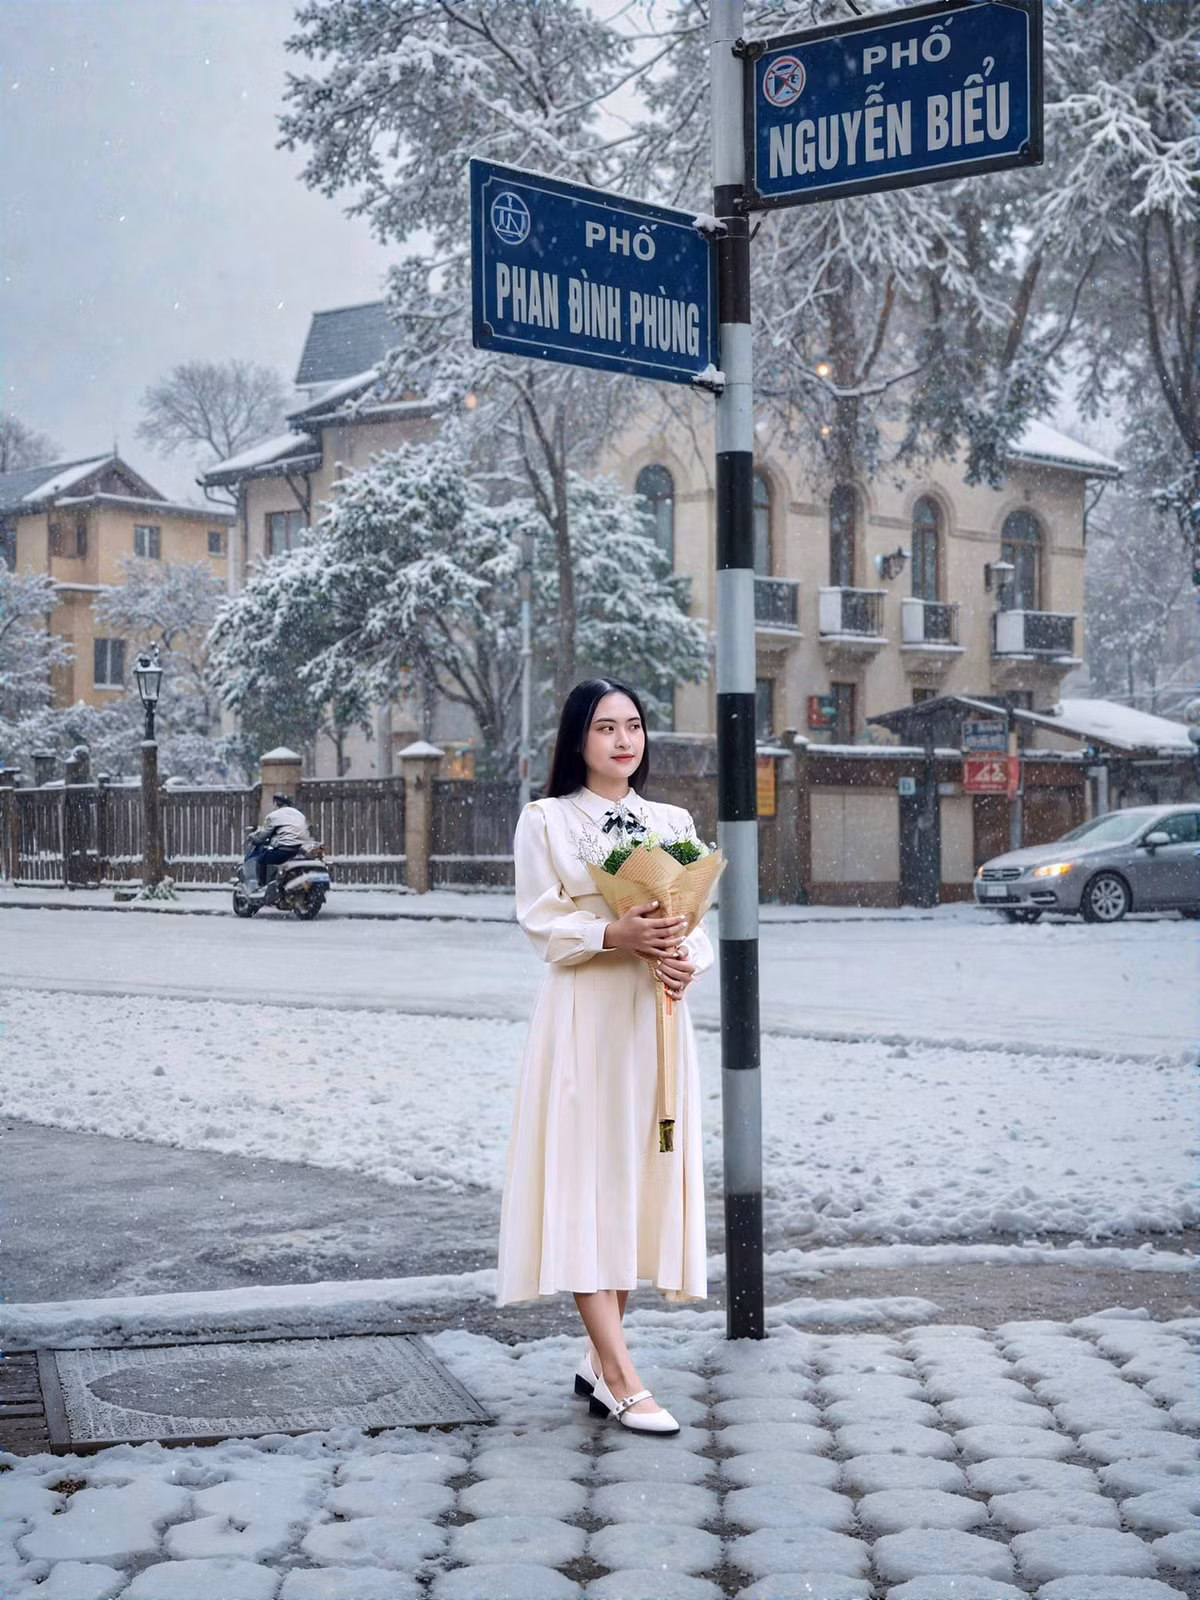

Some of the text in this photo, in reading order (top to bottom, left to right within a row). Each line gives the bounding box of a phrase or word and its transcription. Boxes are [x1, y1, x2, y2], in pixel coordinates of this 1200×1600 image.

[863, 17, 953, 75] PHỐ
[769, 56, 1010, 179] NGUYỄN BIỂU
[585, 221, 658, 262] PHỐ
[496, 262, 700, 357] PHAN ĐÌNH PHÙNG
